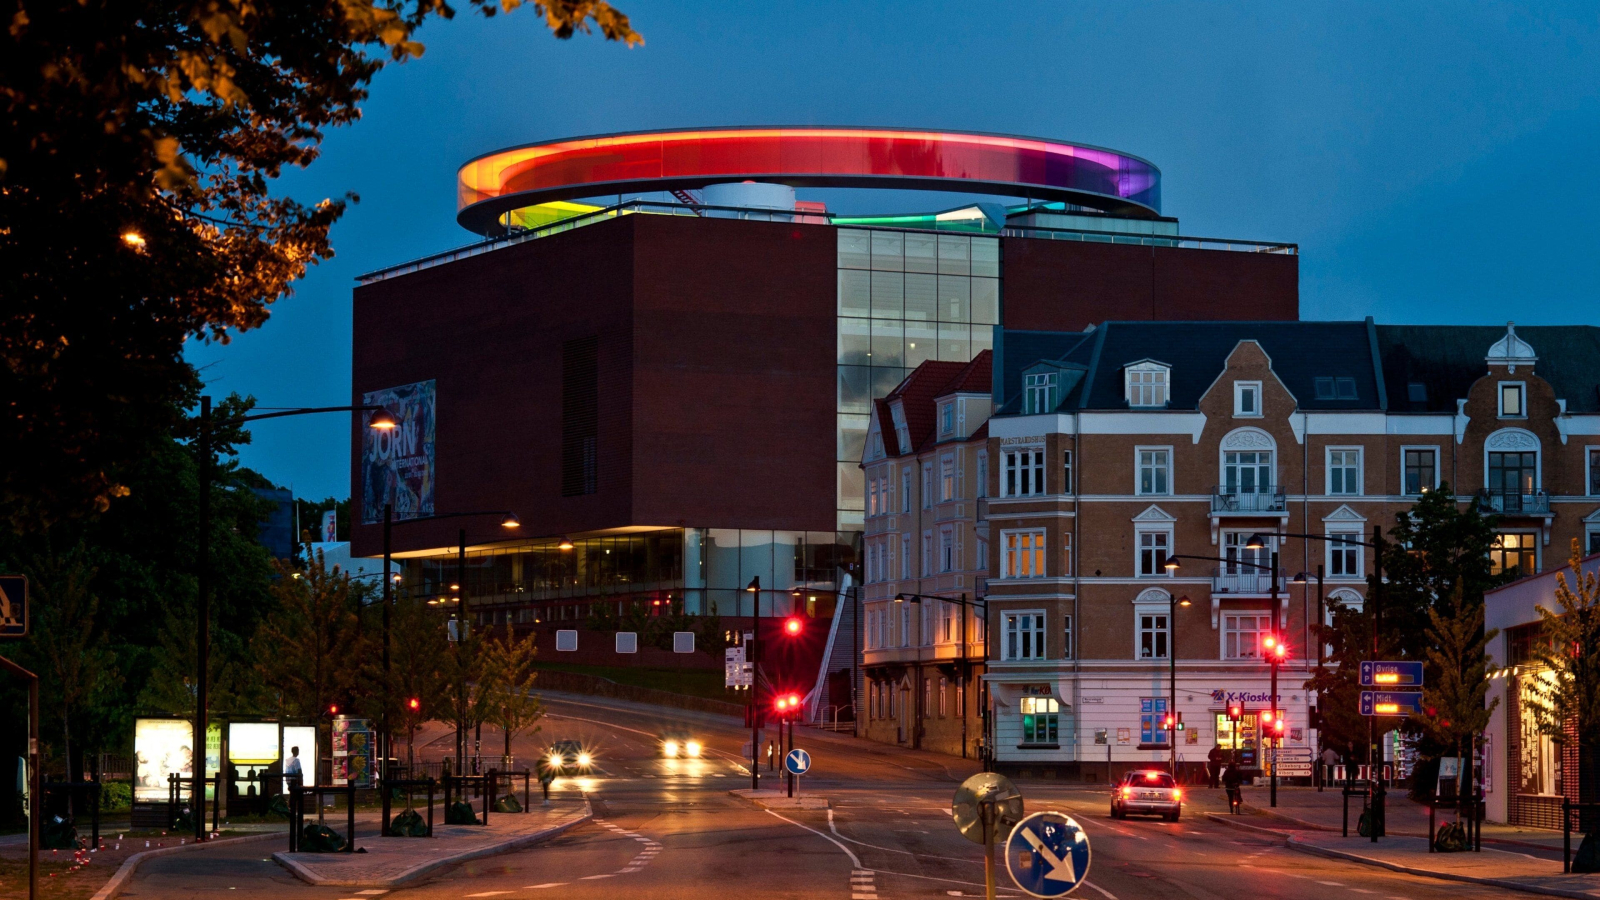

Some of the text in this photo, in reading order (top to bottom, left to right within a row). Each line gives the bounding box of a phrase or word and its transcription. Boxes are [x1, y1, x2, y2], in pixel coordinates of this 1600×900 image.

[369, 421, 416, 462] JORN
[1376, 664, 1398, 673] Øvrige
[1376, 694, 1392, 702] Midt
